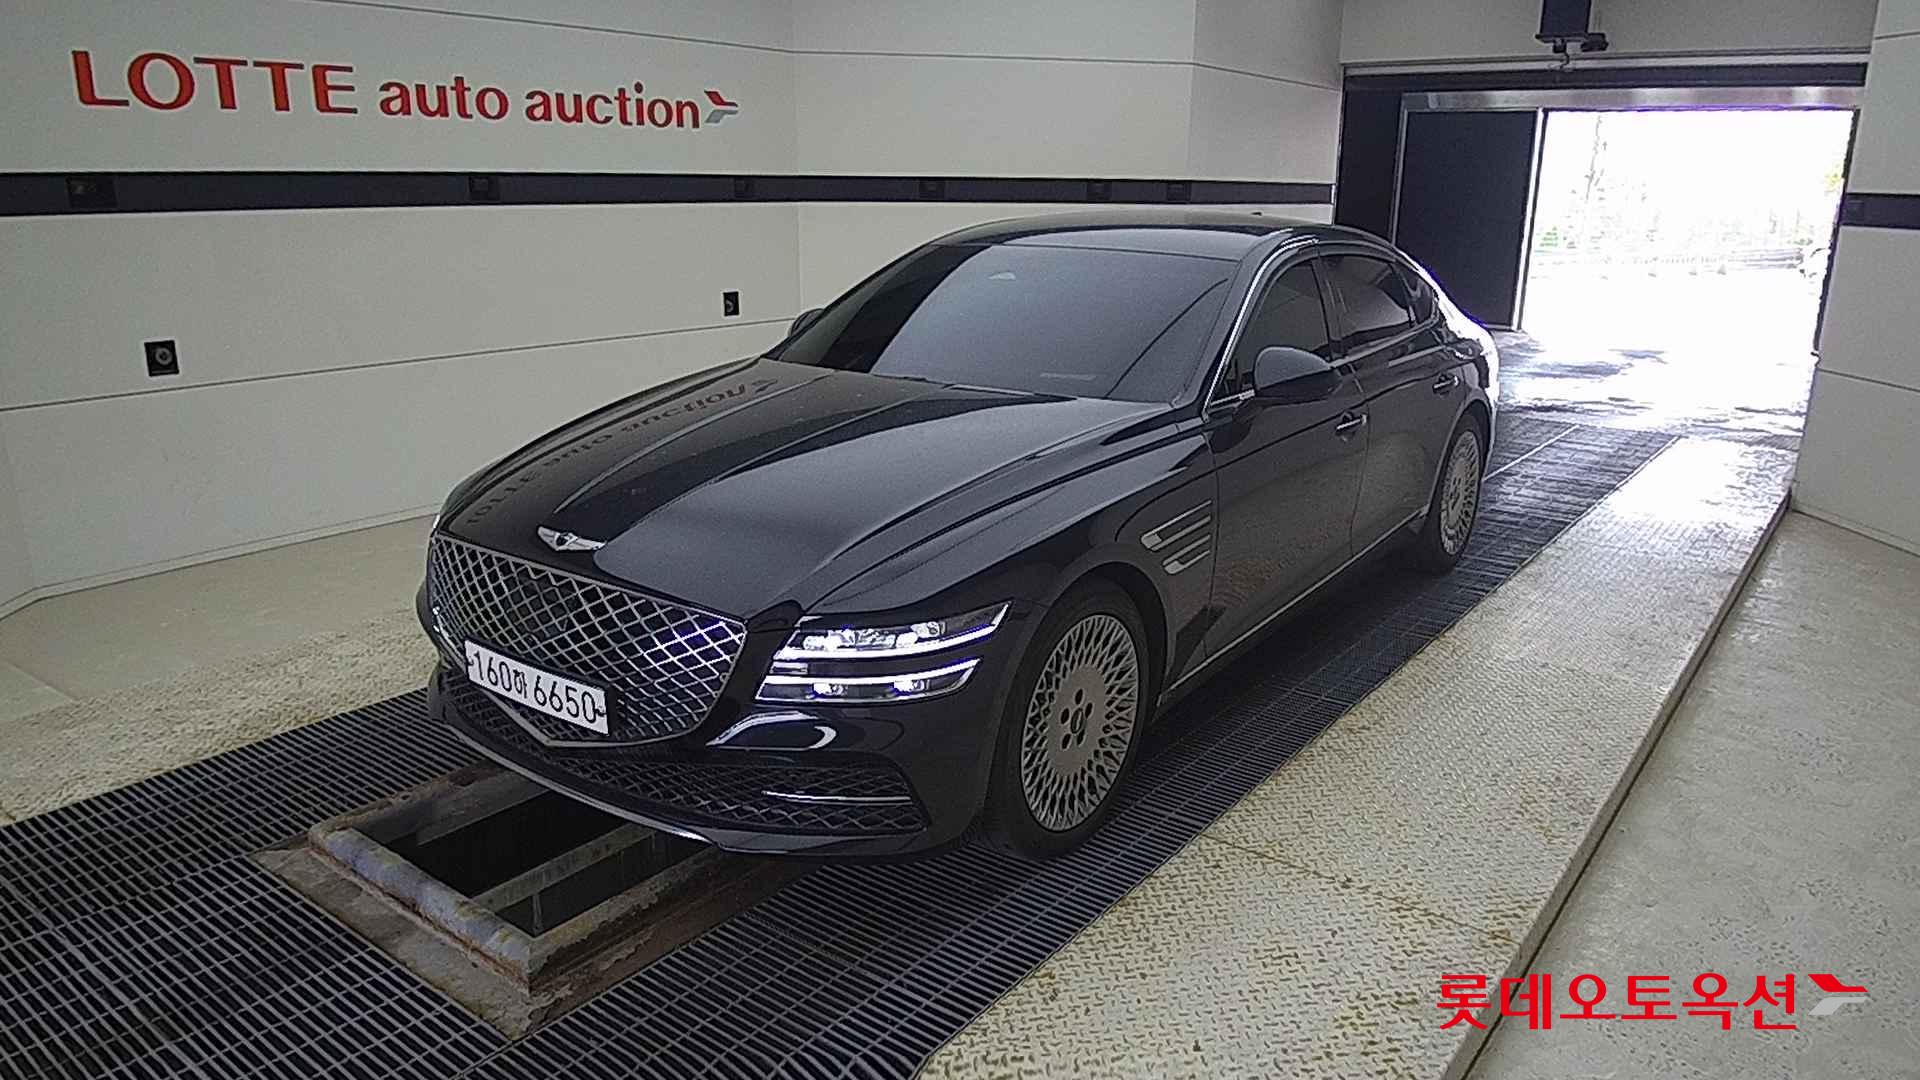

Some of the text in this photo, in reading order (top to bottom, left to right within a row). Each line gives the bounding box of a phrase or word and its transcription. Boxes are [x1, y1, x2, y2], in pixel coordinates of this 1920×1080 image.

[73, 50, 700, 128] LOTTE auto auction
[534, 675, 596, 723] 6650
